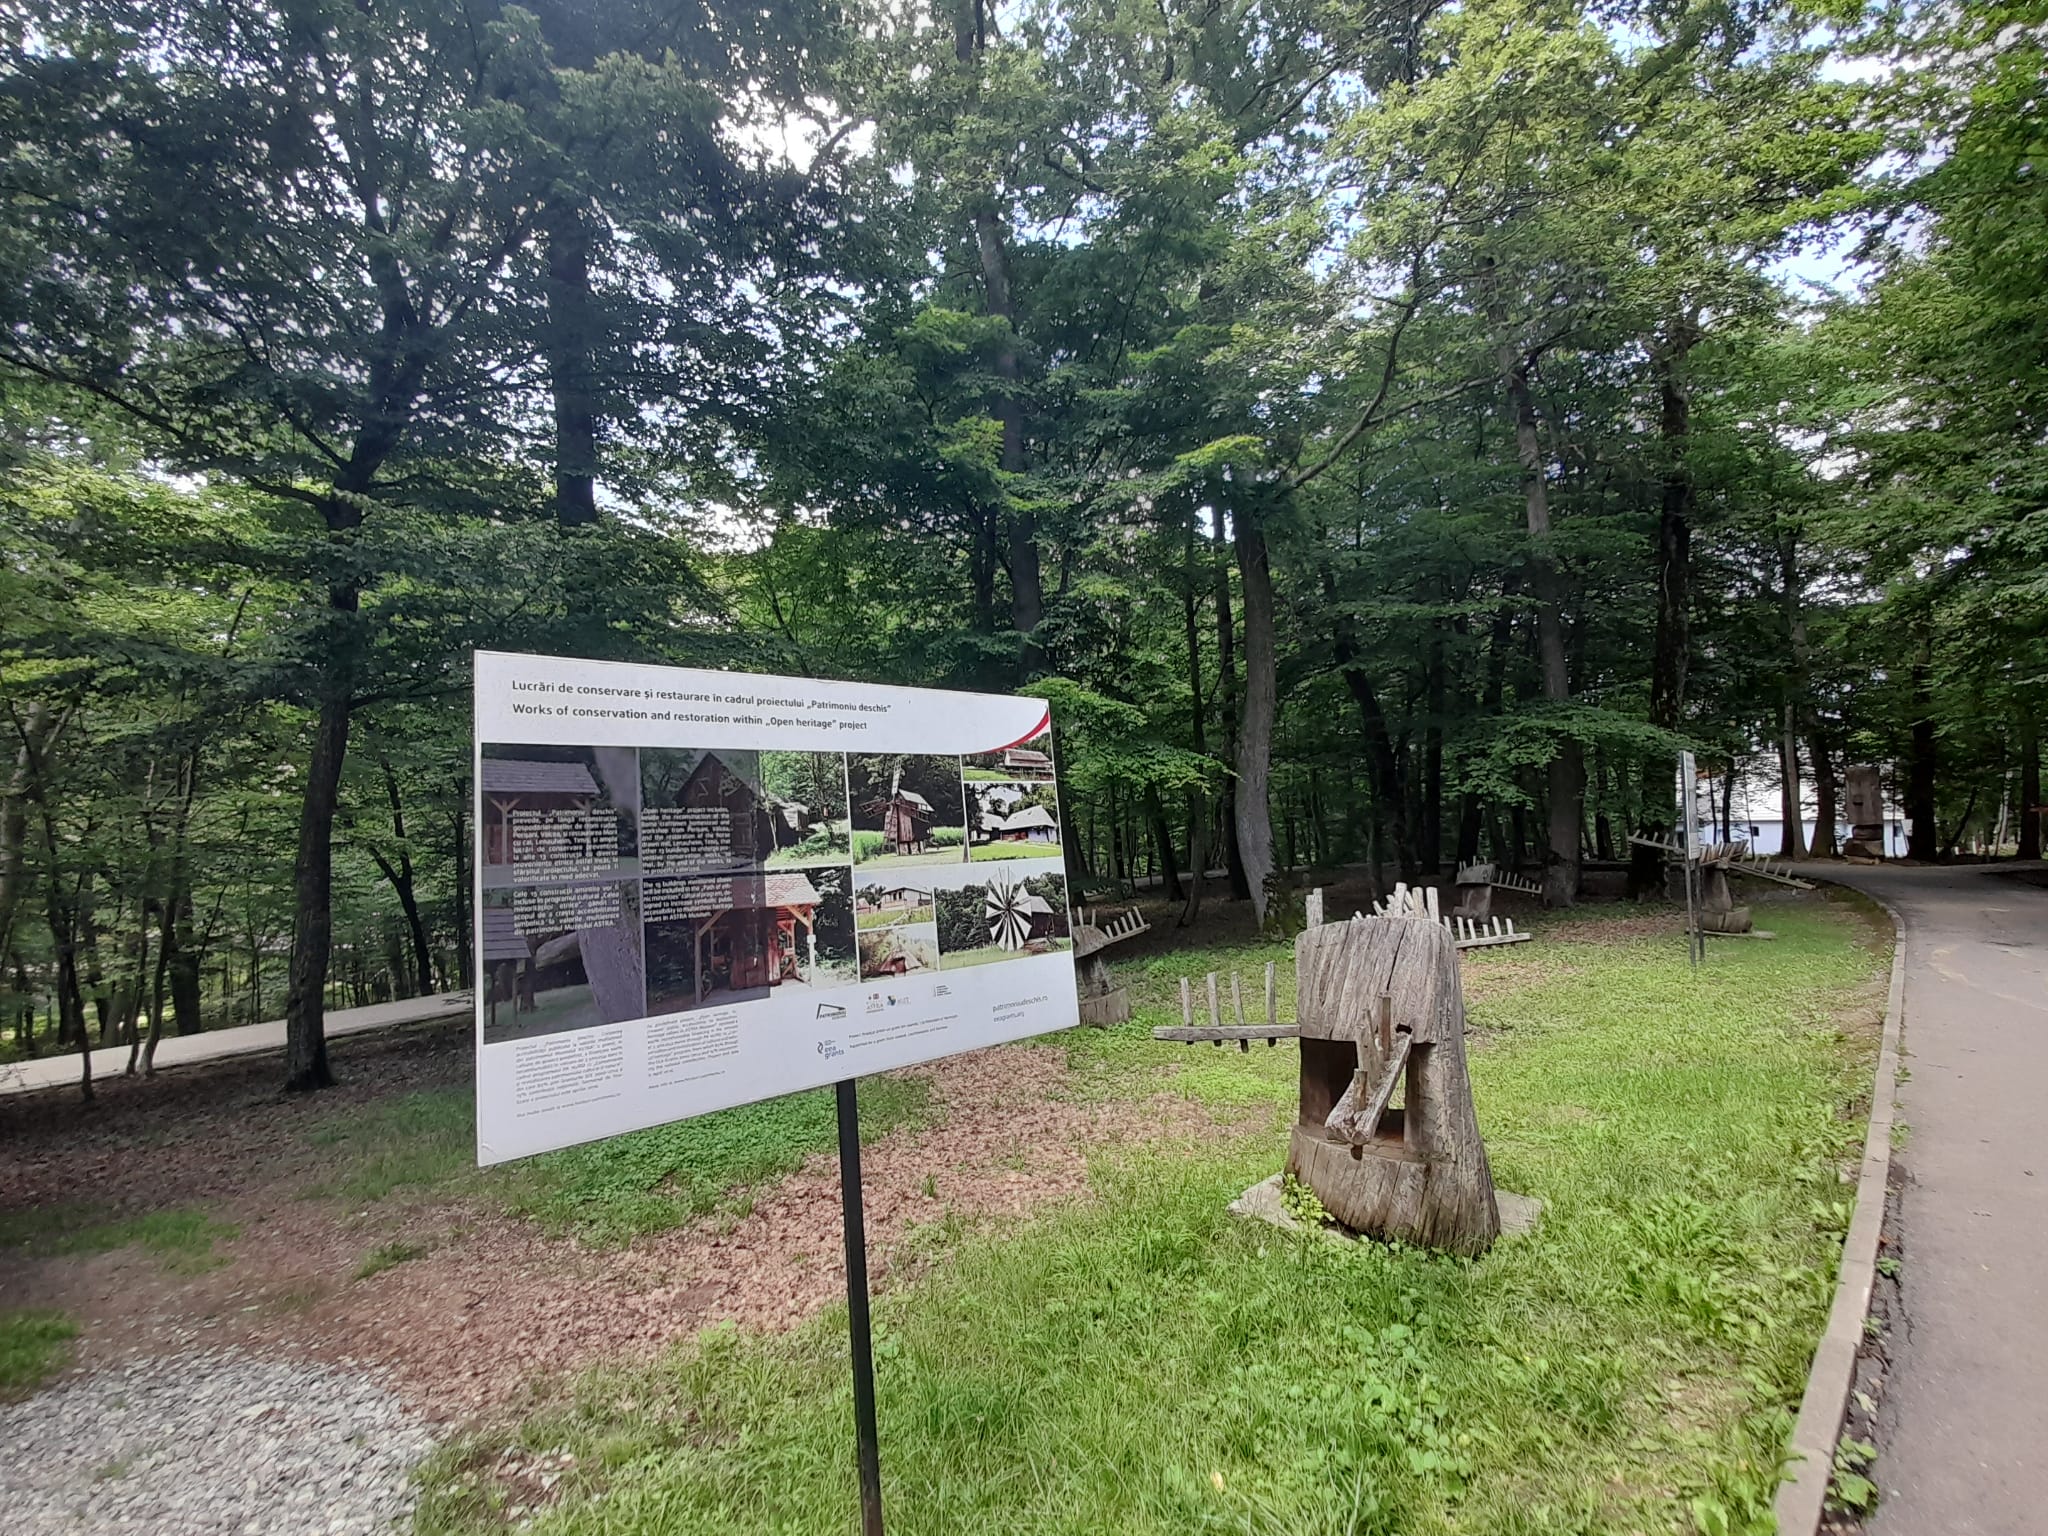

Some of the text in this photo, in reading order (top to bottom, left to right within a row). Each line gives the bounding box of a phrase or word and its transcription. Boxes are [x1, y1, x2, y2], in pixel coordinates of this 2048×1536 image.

[512, 680, 554, 692] Lucrări
[558, 683, 574, 693] de
[577, 686, 641, 698] conservare
[645, 689, 653, 700] și
[656, 690, 710, 702] restaurare
[713, 694, 722, 703] în
[724, 695, 754, 705] cadrul
[757, 697, 805, 708] proiectului
[512, 703, 553, 714] Works
[556, 705, 568, 715] of
[572, 708, 648, 720] conservation
[650, 711, 671, 721] and
[674, 711, 730, 723] restoration
[733, 715, 763, 725] within
[839, 721, 867, 731] project
